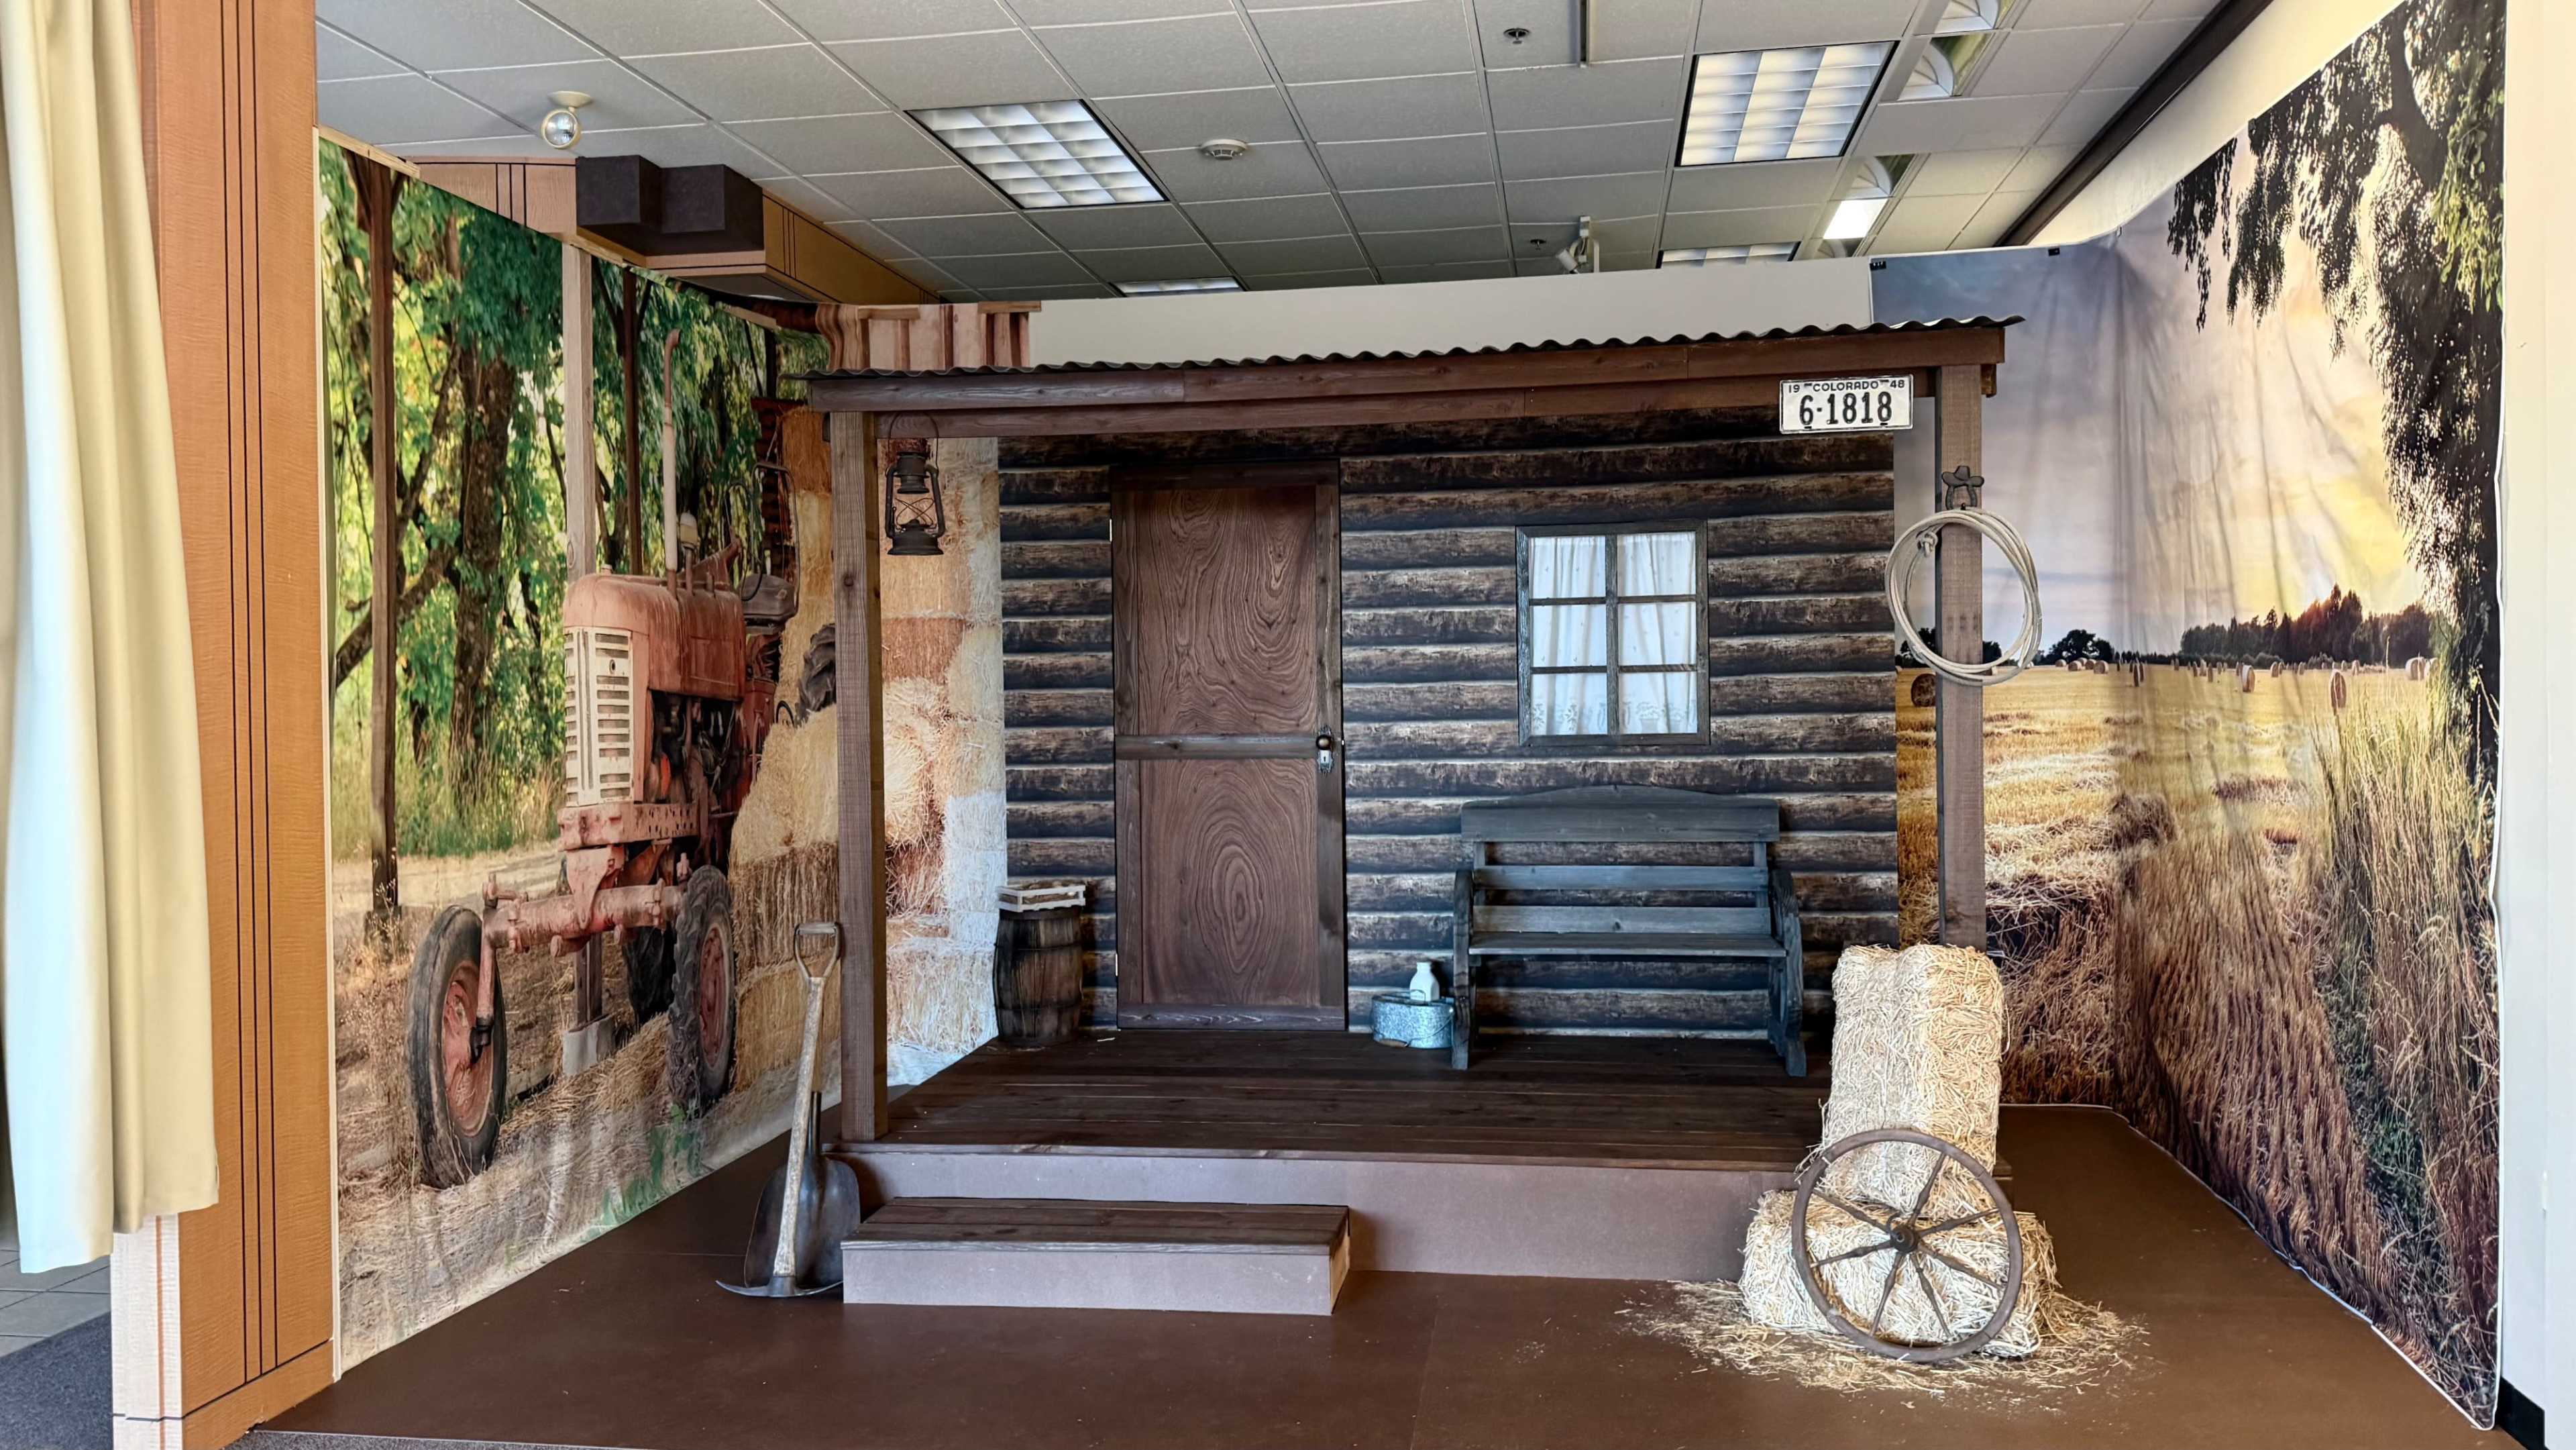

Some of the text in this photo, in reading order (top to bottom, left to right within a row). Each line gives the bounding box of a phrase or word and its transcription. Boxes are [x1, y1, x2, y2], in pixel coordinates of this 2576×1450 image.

[1788, 379, 1905, 393] 19 COLORADO 48
[1799, 391, 1892, 425] 6-1818
